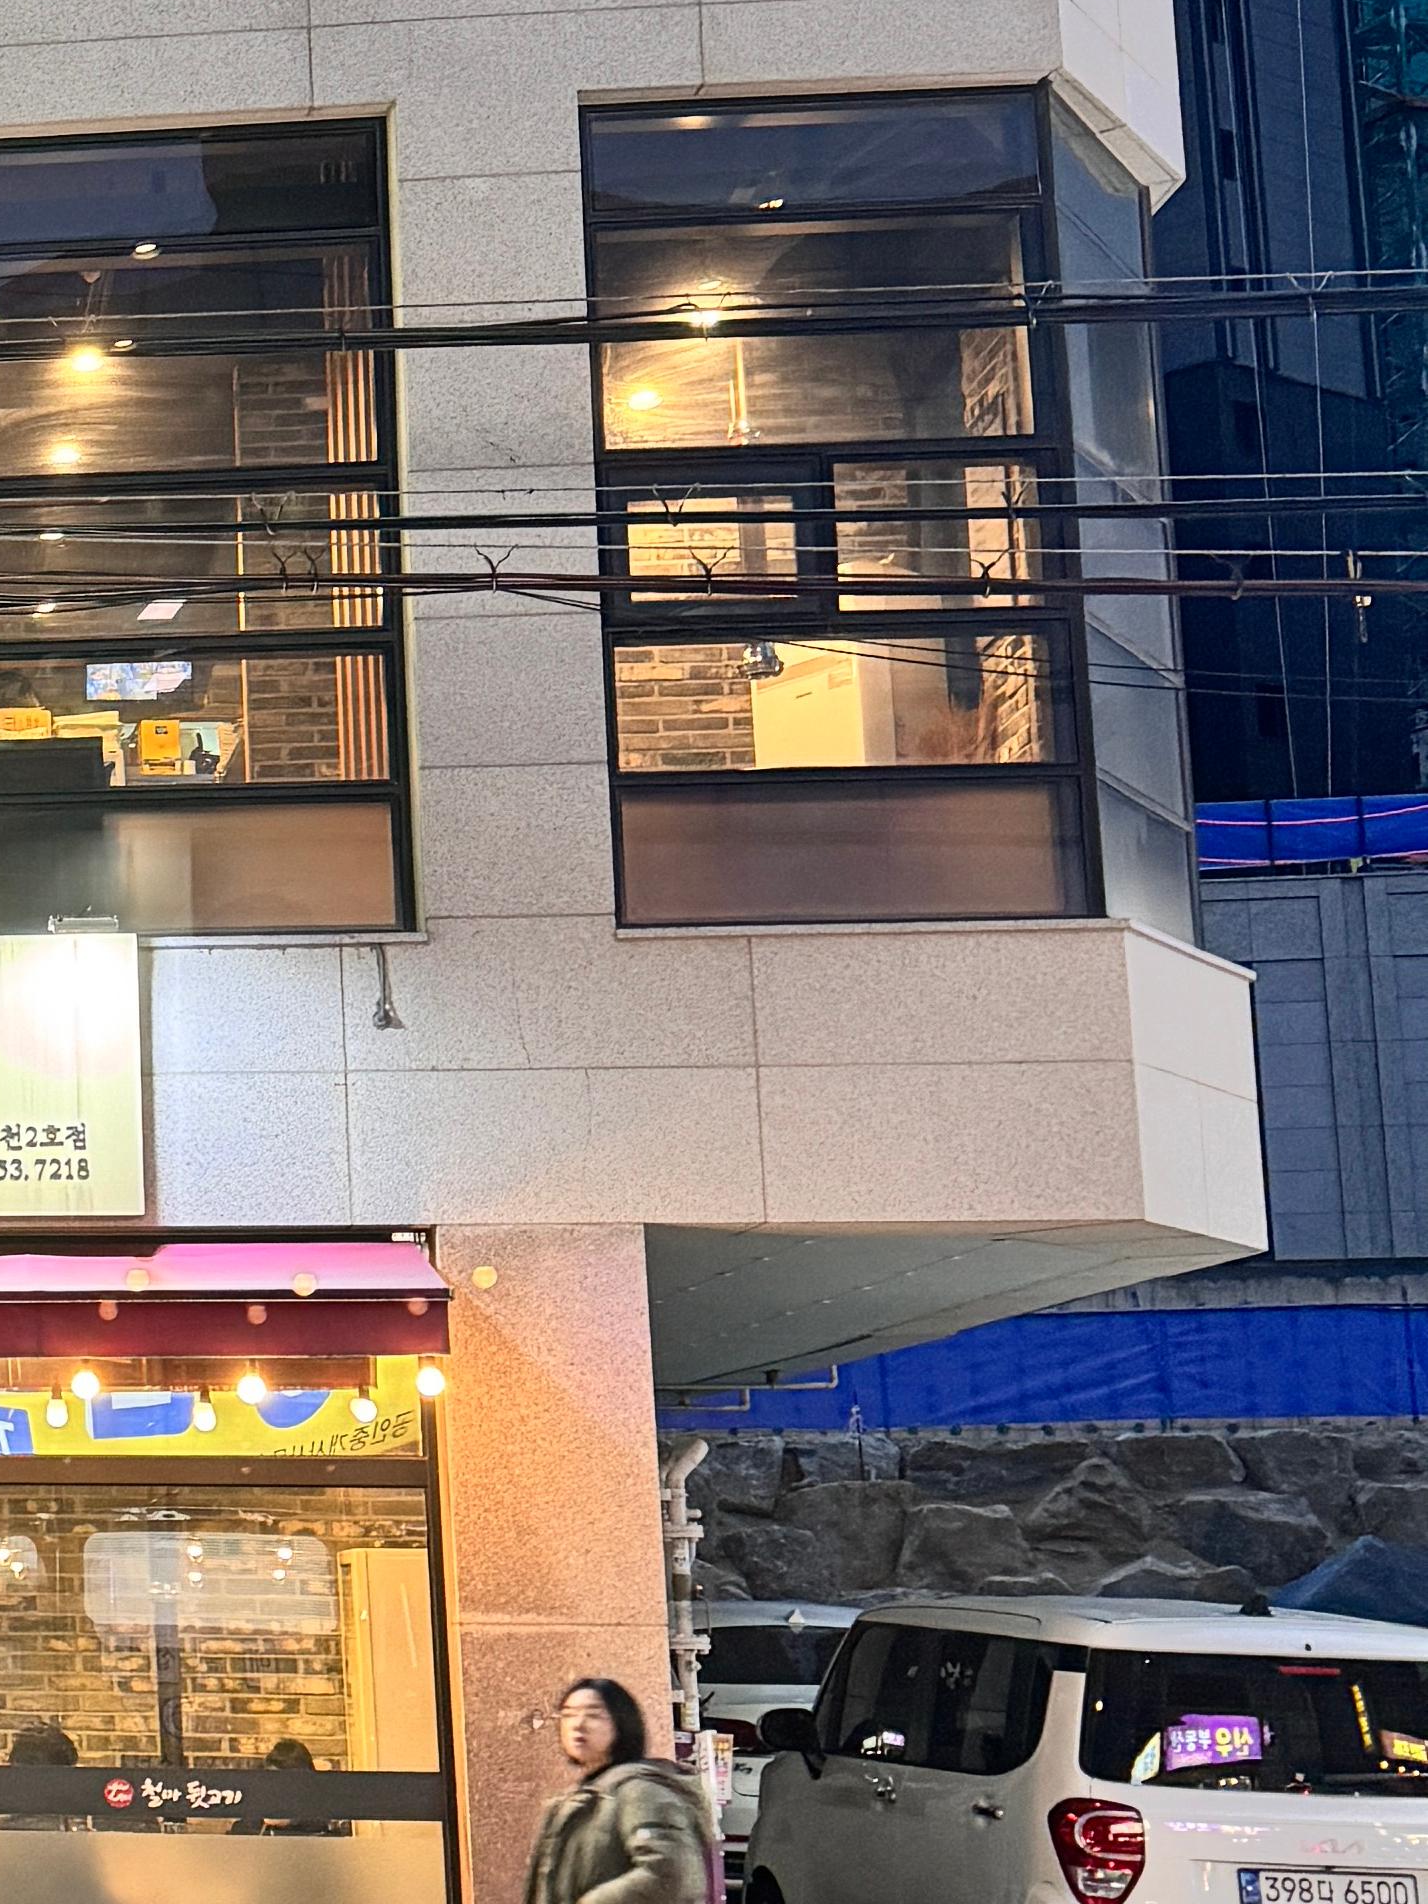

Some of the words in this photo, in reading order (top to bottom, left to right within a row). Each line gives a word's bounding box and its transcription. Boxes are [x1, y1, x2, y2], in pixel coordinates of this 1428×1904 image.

[140, 1777, 183, 1808] 철마
[185, 1780, 243, 1809] 뒷고기
[1265, 1876, 1334, 1904] 398다
